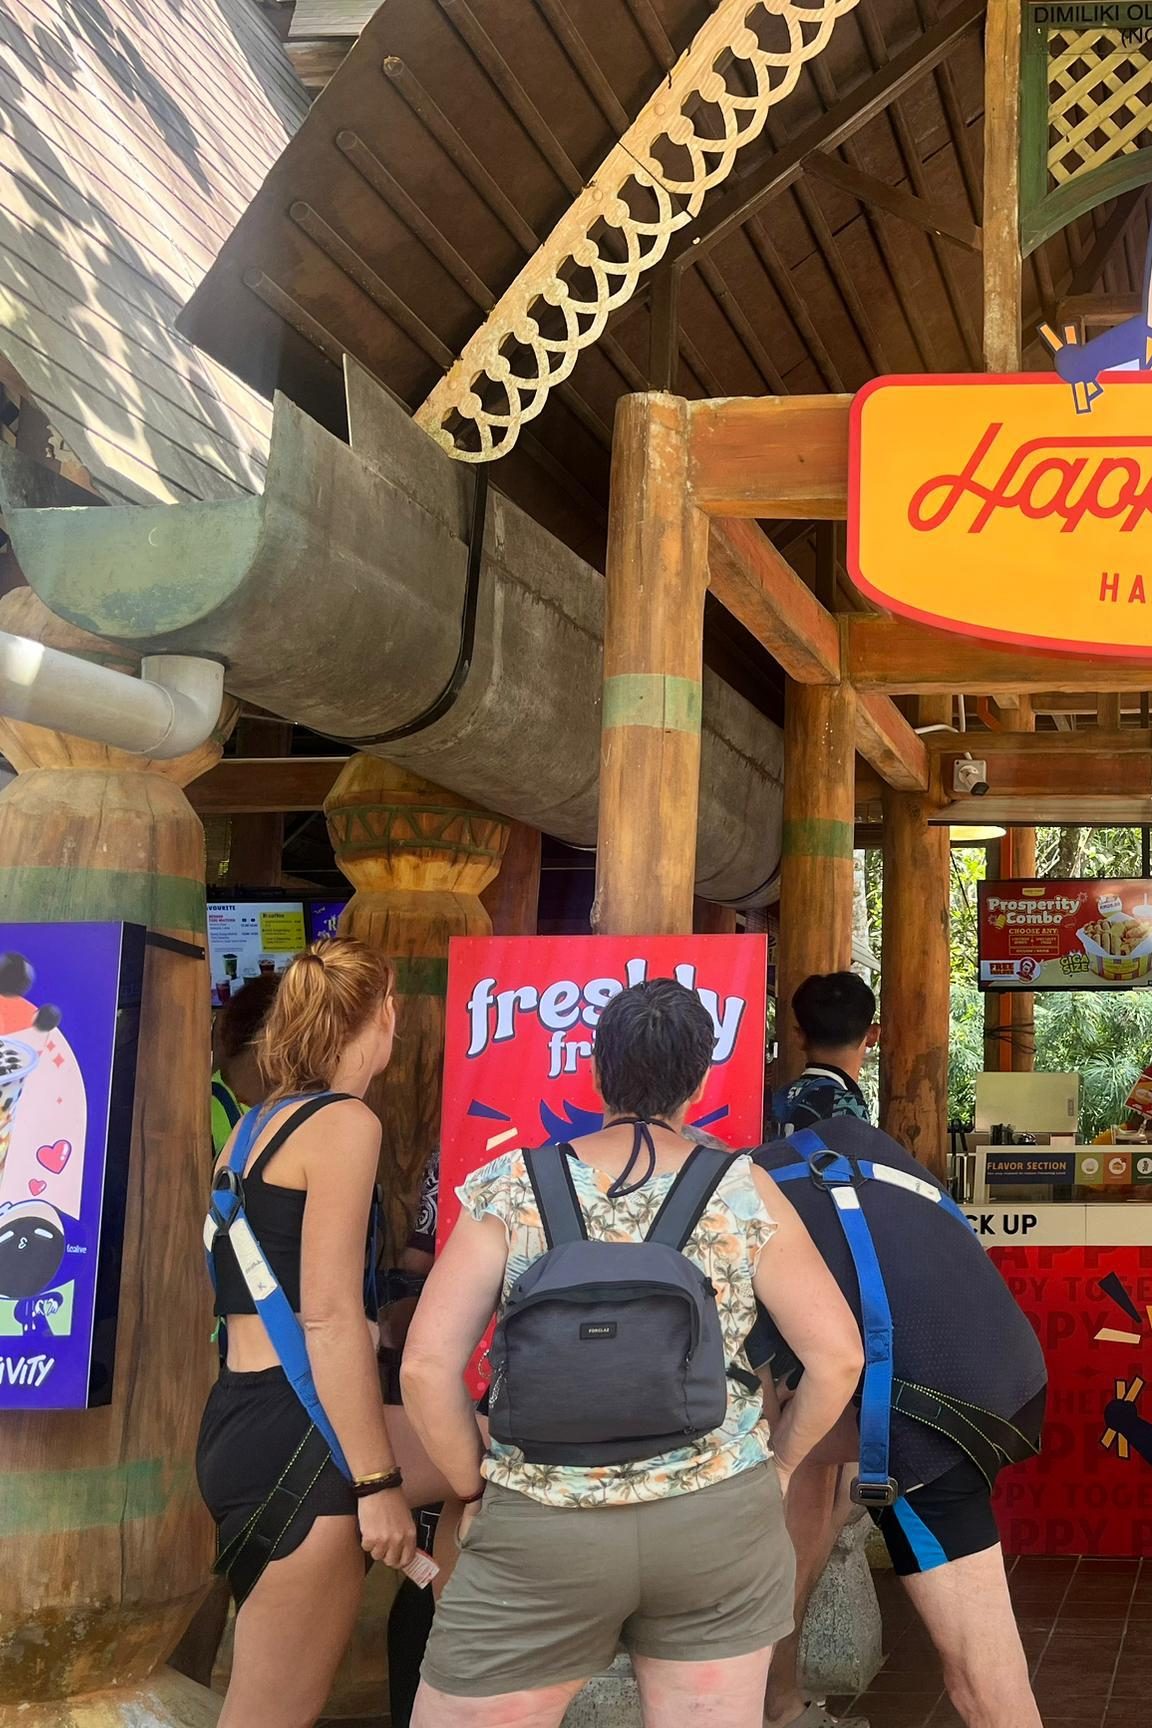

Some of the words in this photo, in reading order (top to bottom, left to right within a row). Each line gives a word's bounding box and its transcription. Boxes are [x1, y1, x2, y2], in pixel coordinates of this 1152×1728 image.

[1033, 4, 1120, 23] DIMILIKI
[987, 896, 1081, 914] Prosperity
[1006, 912, 1063, 925] Combo
[1060, 954, 1089, 967] GIGA
[1062, 964, 1089, 975] SIZE
[467, 958, 746, 1064] fresy
[987, 1162, 1024, 1170] FLAVOR
[1026, 1161, 1067, 1170] SECTION
[1003, 1214, 1038, 1235] UP
